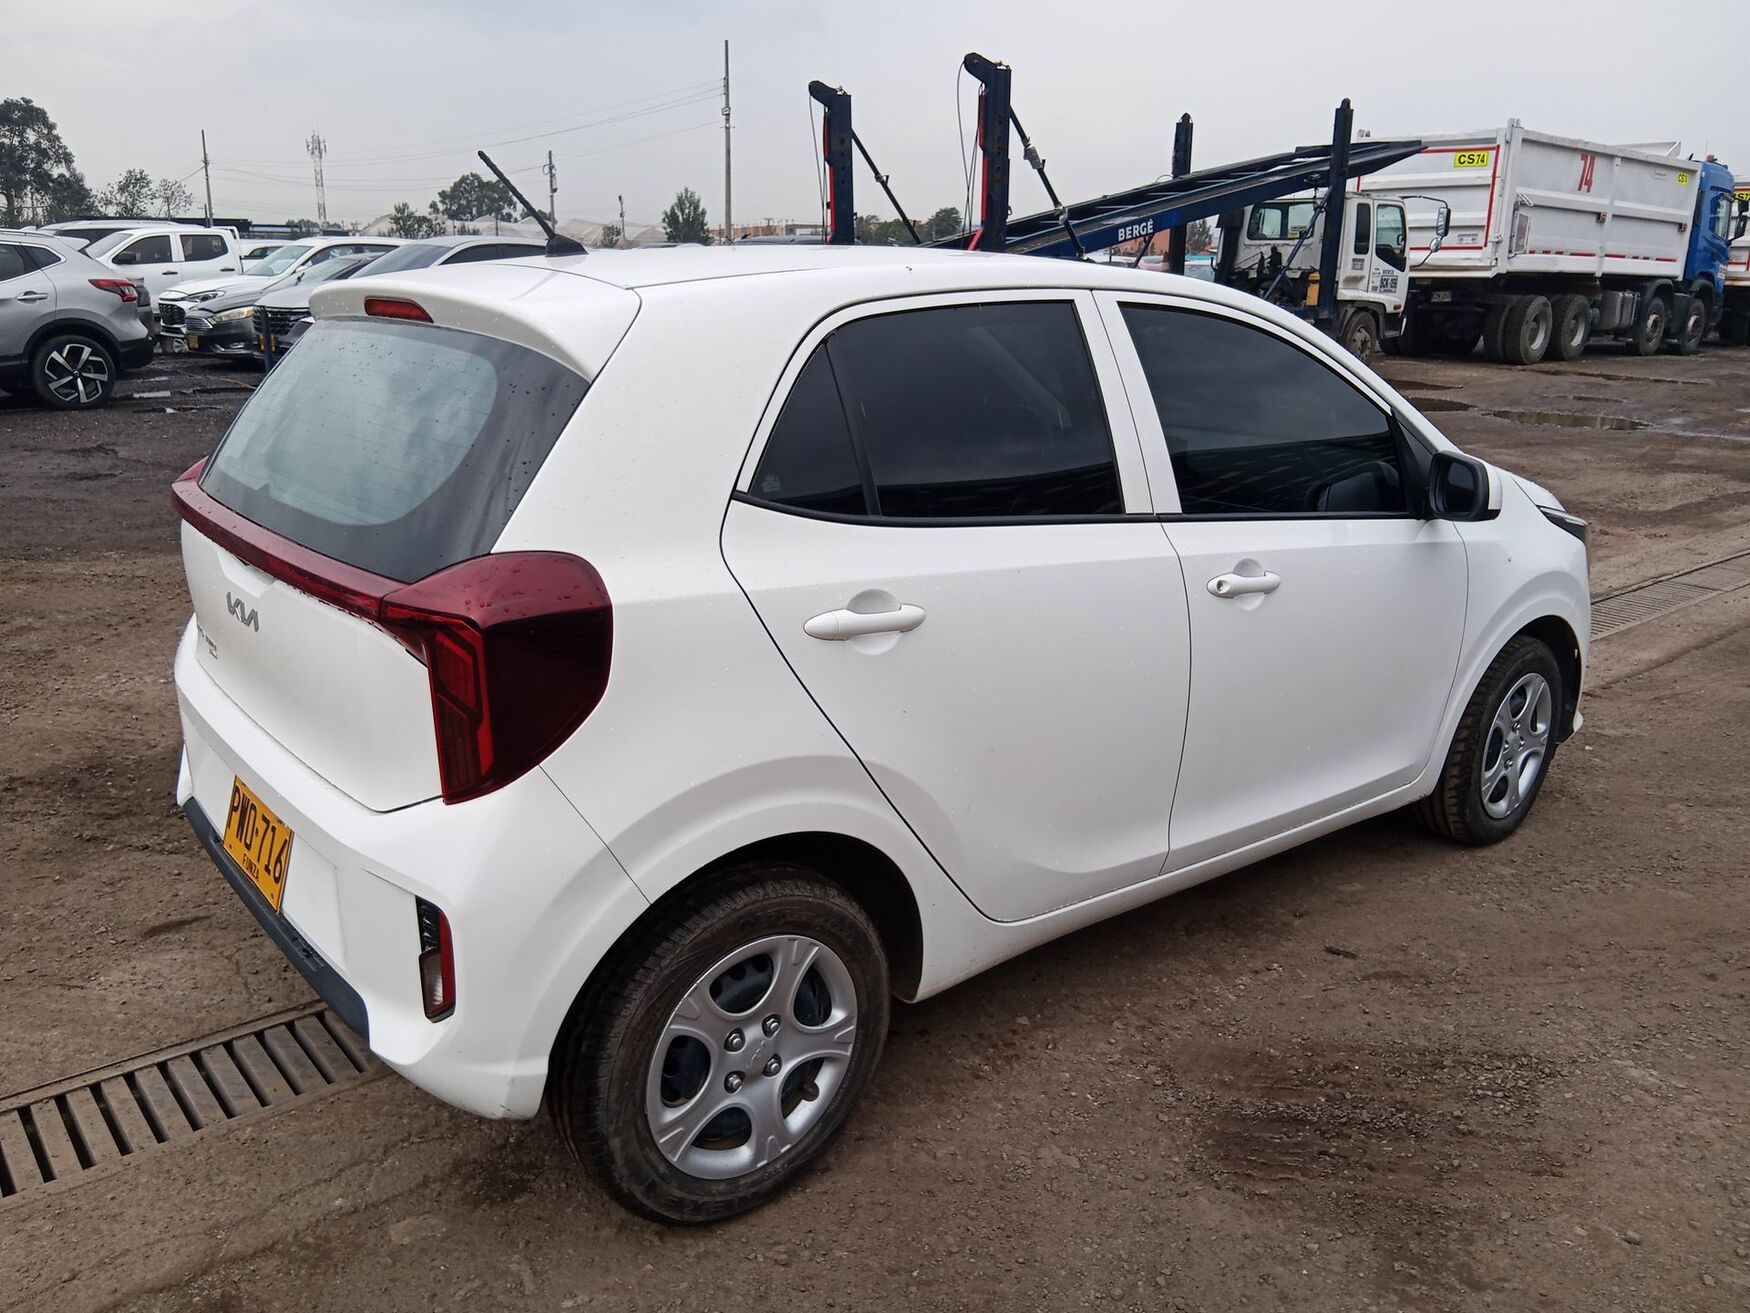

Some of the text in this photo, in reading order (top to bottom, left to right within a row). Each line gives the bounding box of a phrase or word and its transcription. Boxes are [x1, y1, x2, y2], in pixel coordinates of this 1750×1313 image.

[1458, 153, 1485, 165] CS74
[1577, 153, 1597, 193] 74
[226, 591, 260, 633] KIA
